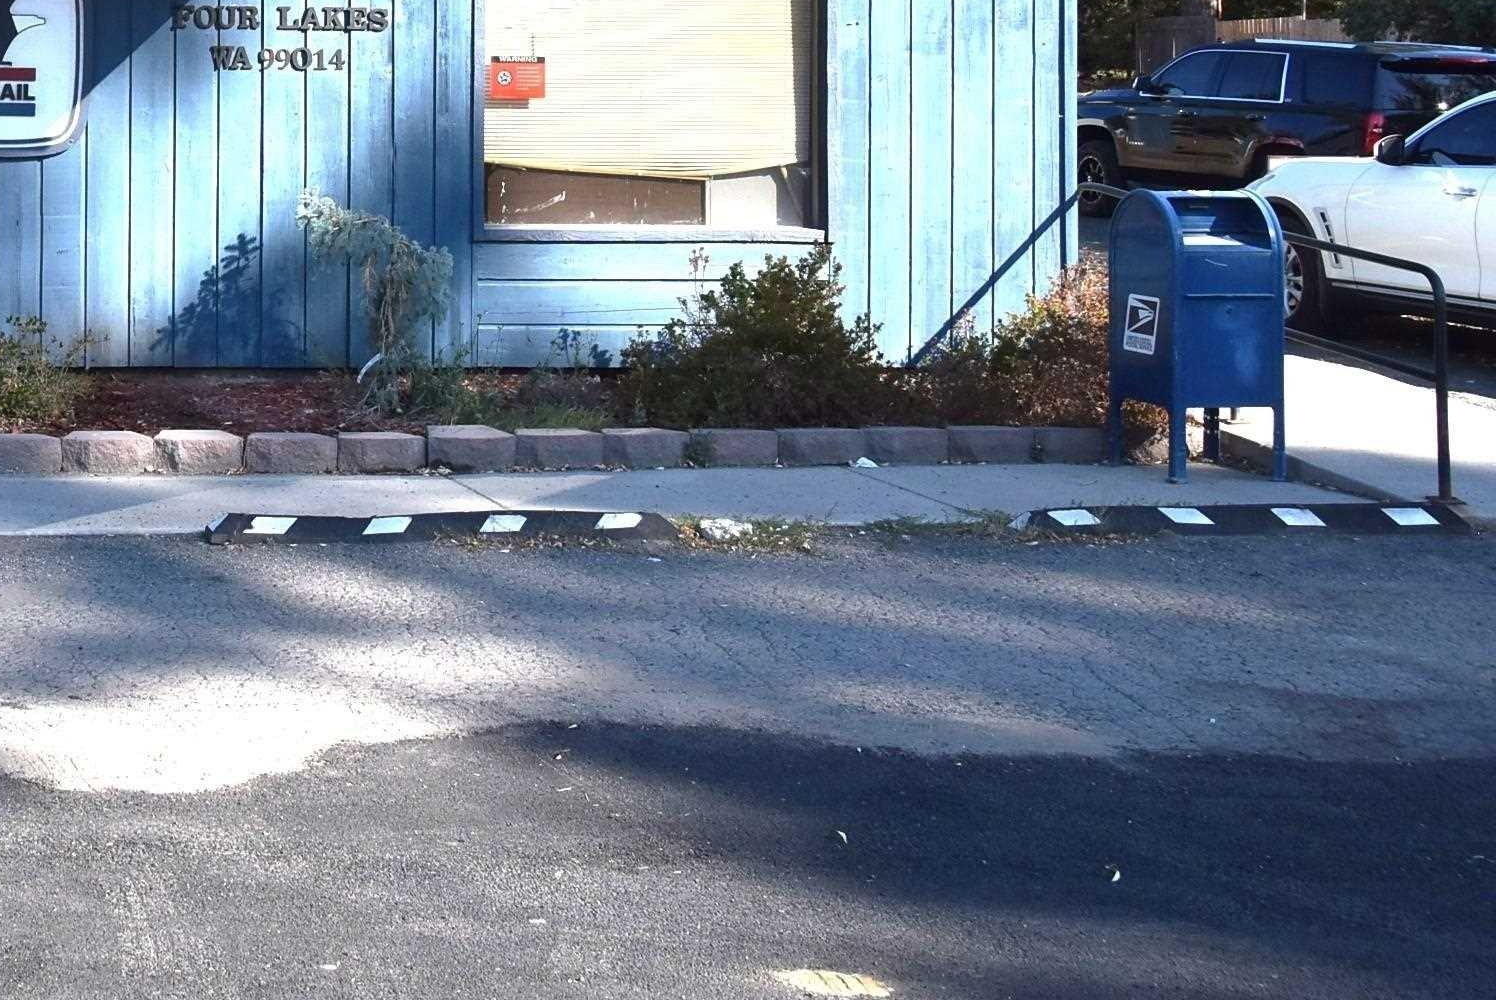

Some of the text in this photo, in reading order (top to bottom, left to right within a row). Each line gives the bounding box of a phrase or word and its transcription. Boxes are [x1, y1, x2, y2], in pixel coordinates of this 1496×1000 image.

[170, 4, 389, 32] FOUR LAKES
[209, 45, 346, 72] WA 99014
